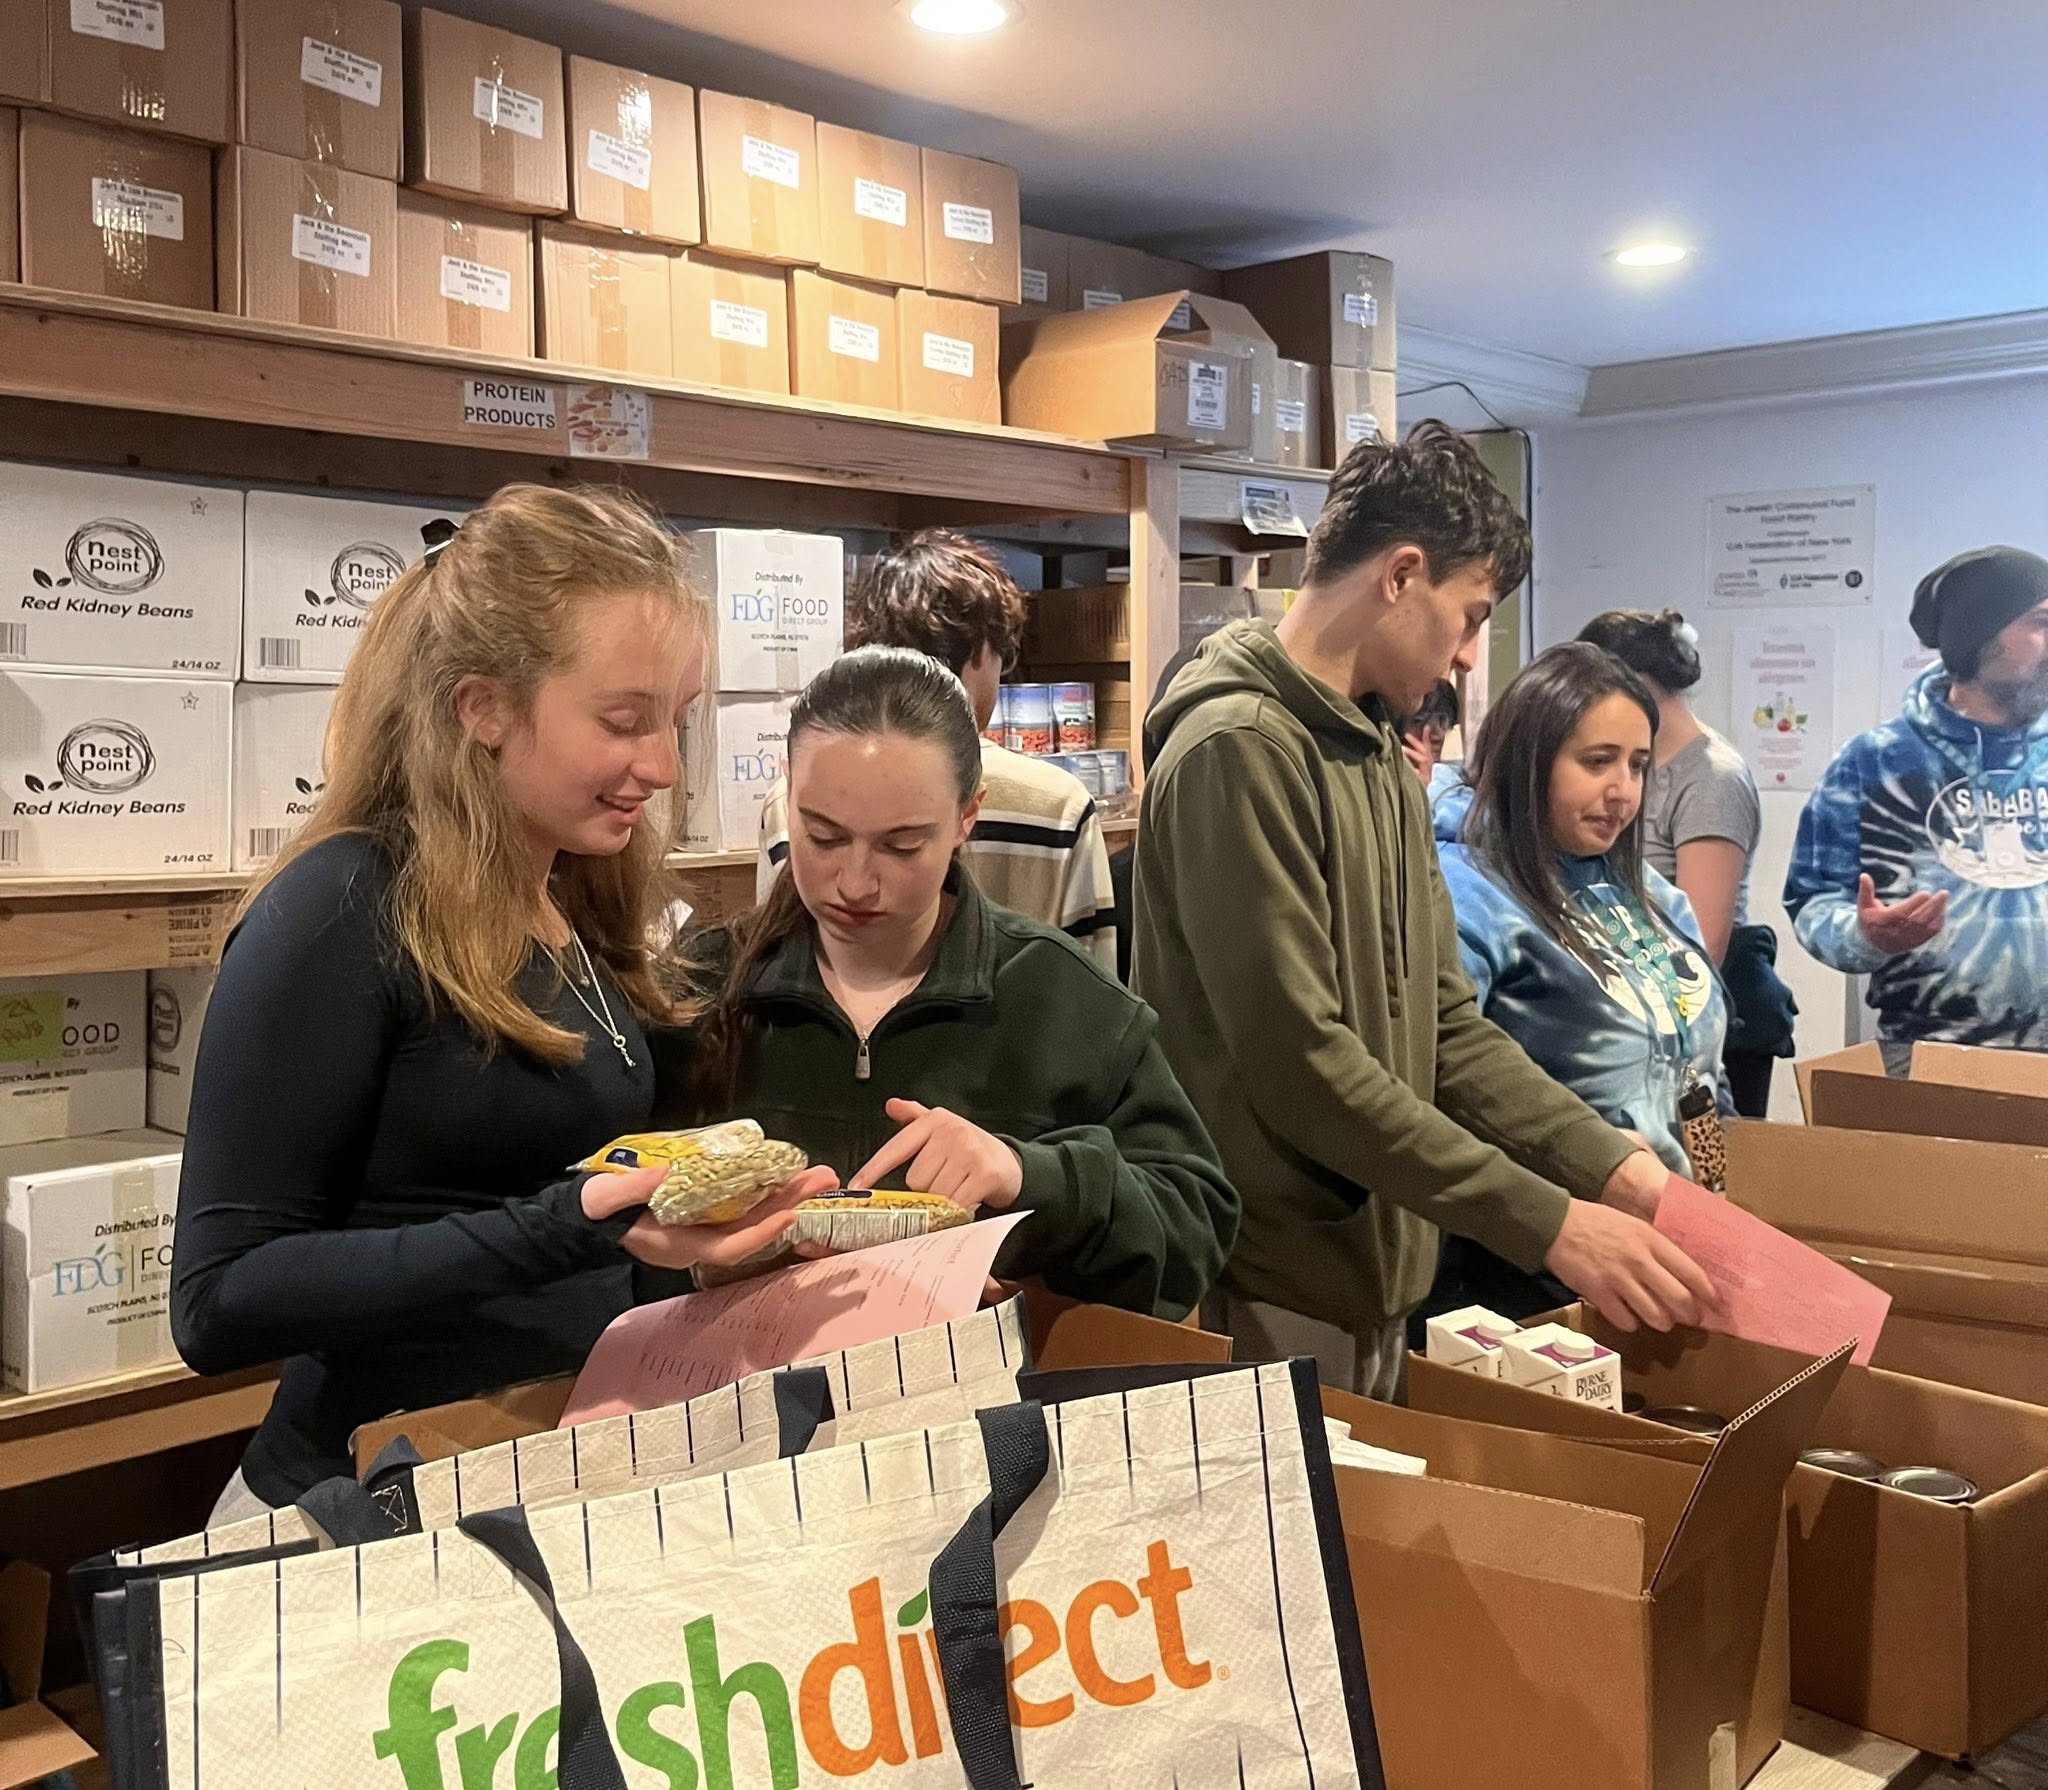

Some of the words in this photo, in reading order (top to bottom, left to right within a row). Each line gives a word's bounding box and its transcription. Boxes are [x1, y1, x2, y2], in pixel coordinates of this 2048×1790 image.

[474, 382, 546, 404] PROTEIN
[464, 406, 556, 429] PRODUCTS
[88, 541, 142, 560] nest
[90, 558, 141, 573] point
[349, 563, 393, 579] nest
[21, 595, 61, 611] Red
[66, 598, 132, 619] Kidney
[137, 603, 194, 619] Beans
[731, 593, 775, 622] FDG
[783, 598, 829, 616] FOOD
[296, 614, 327, 627] Red
[205, 661, 221, 670] OZ
[757, 733, 788, 742] Distribut
[79, 742, 134, 759] nest
[81, 758, 131, 774] point
[732, 753, 776, 782] FDG
[13, 801, 52, 815] Red
[58, 801, 124, 817] Kidney
[129, 800, 185, 814] Beans
[164, 854, 194, 863] 24/14
[197, 854, 213, 863] OZ
[62, 1022, 120, 1046] OOD
[94, 1215, 159, 1237] Distributed
[161, 1213, 175, 1227] By
[52, 1250, 126, 1297] FDG
[1576, 1370, 1607, 1397] BYRNE
[1585, 1380, 1613, 1401] DAIRY
